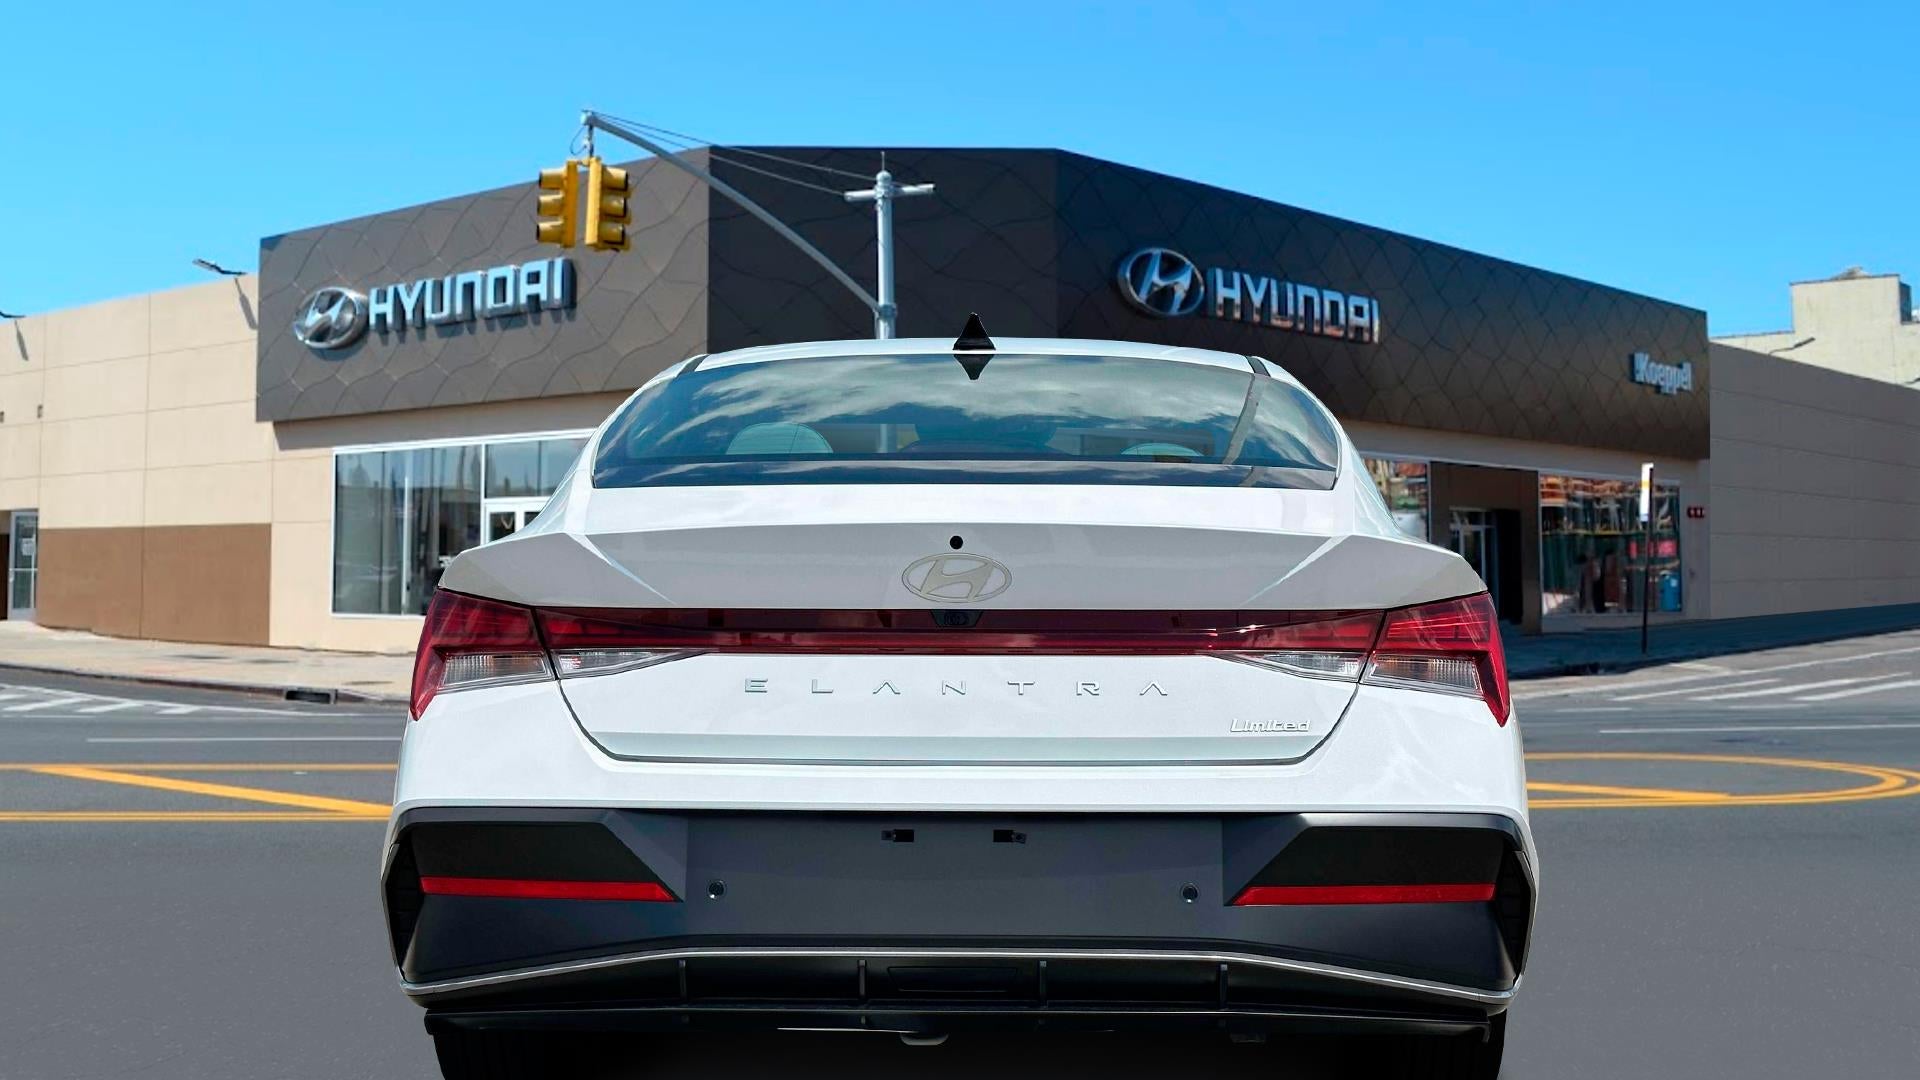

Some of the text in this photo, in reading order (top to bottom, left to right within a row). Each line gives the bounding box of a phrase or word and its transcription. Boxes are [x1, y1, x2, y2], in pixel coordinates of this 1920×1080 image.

[368, 256, 571, 333] HYUNDAI
[1214, 267, 1380, 344] HYUNDAI
[744, 677, 1168, 697] ELANTRA
[1230, 718, 1311, 733] Limited
